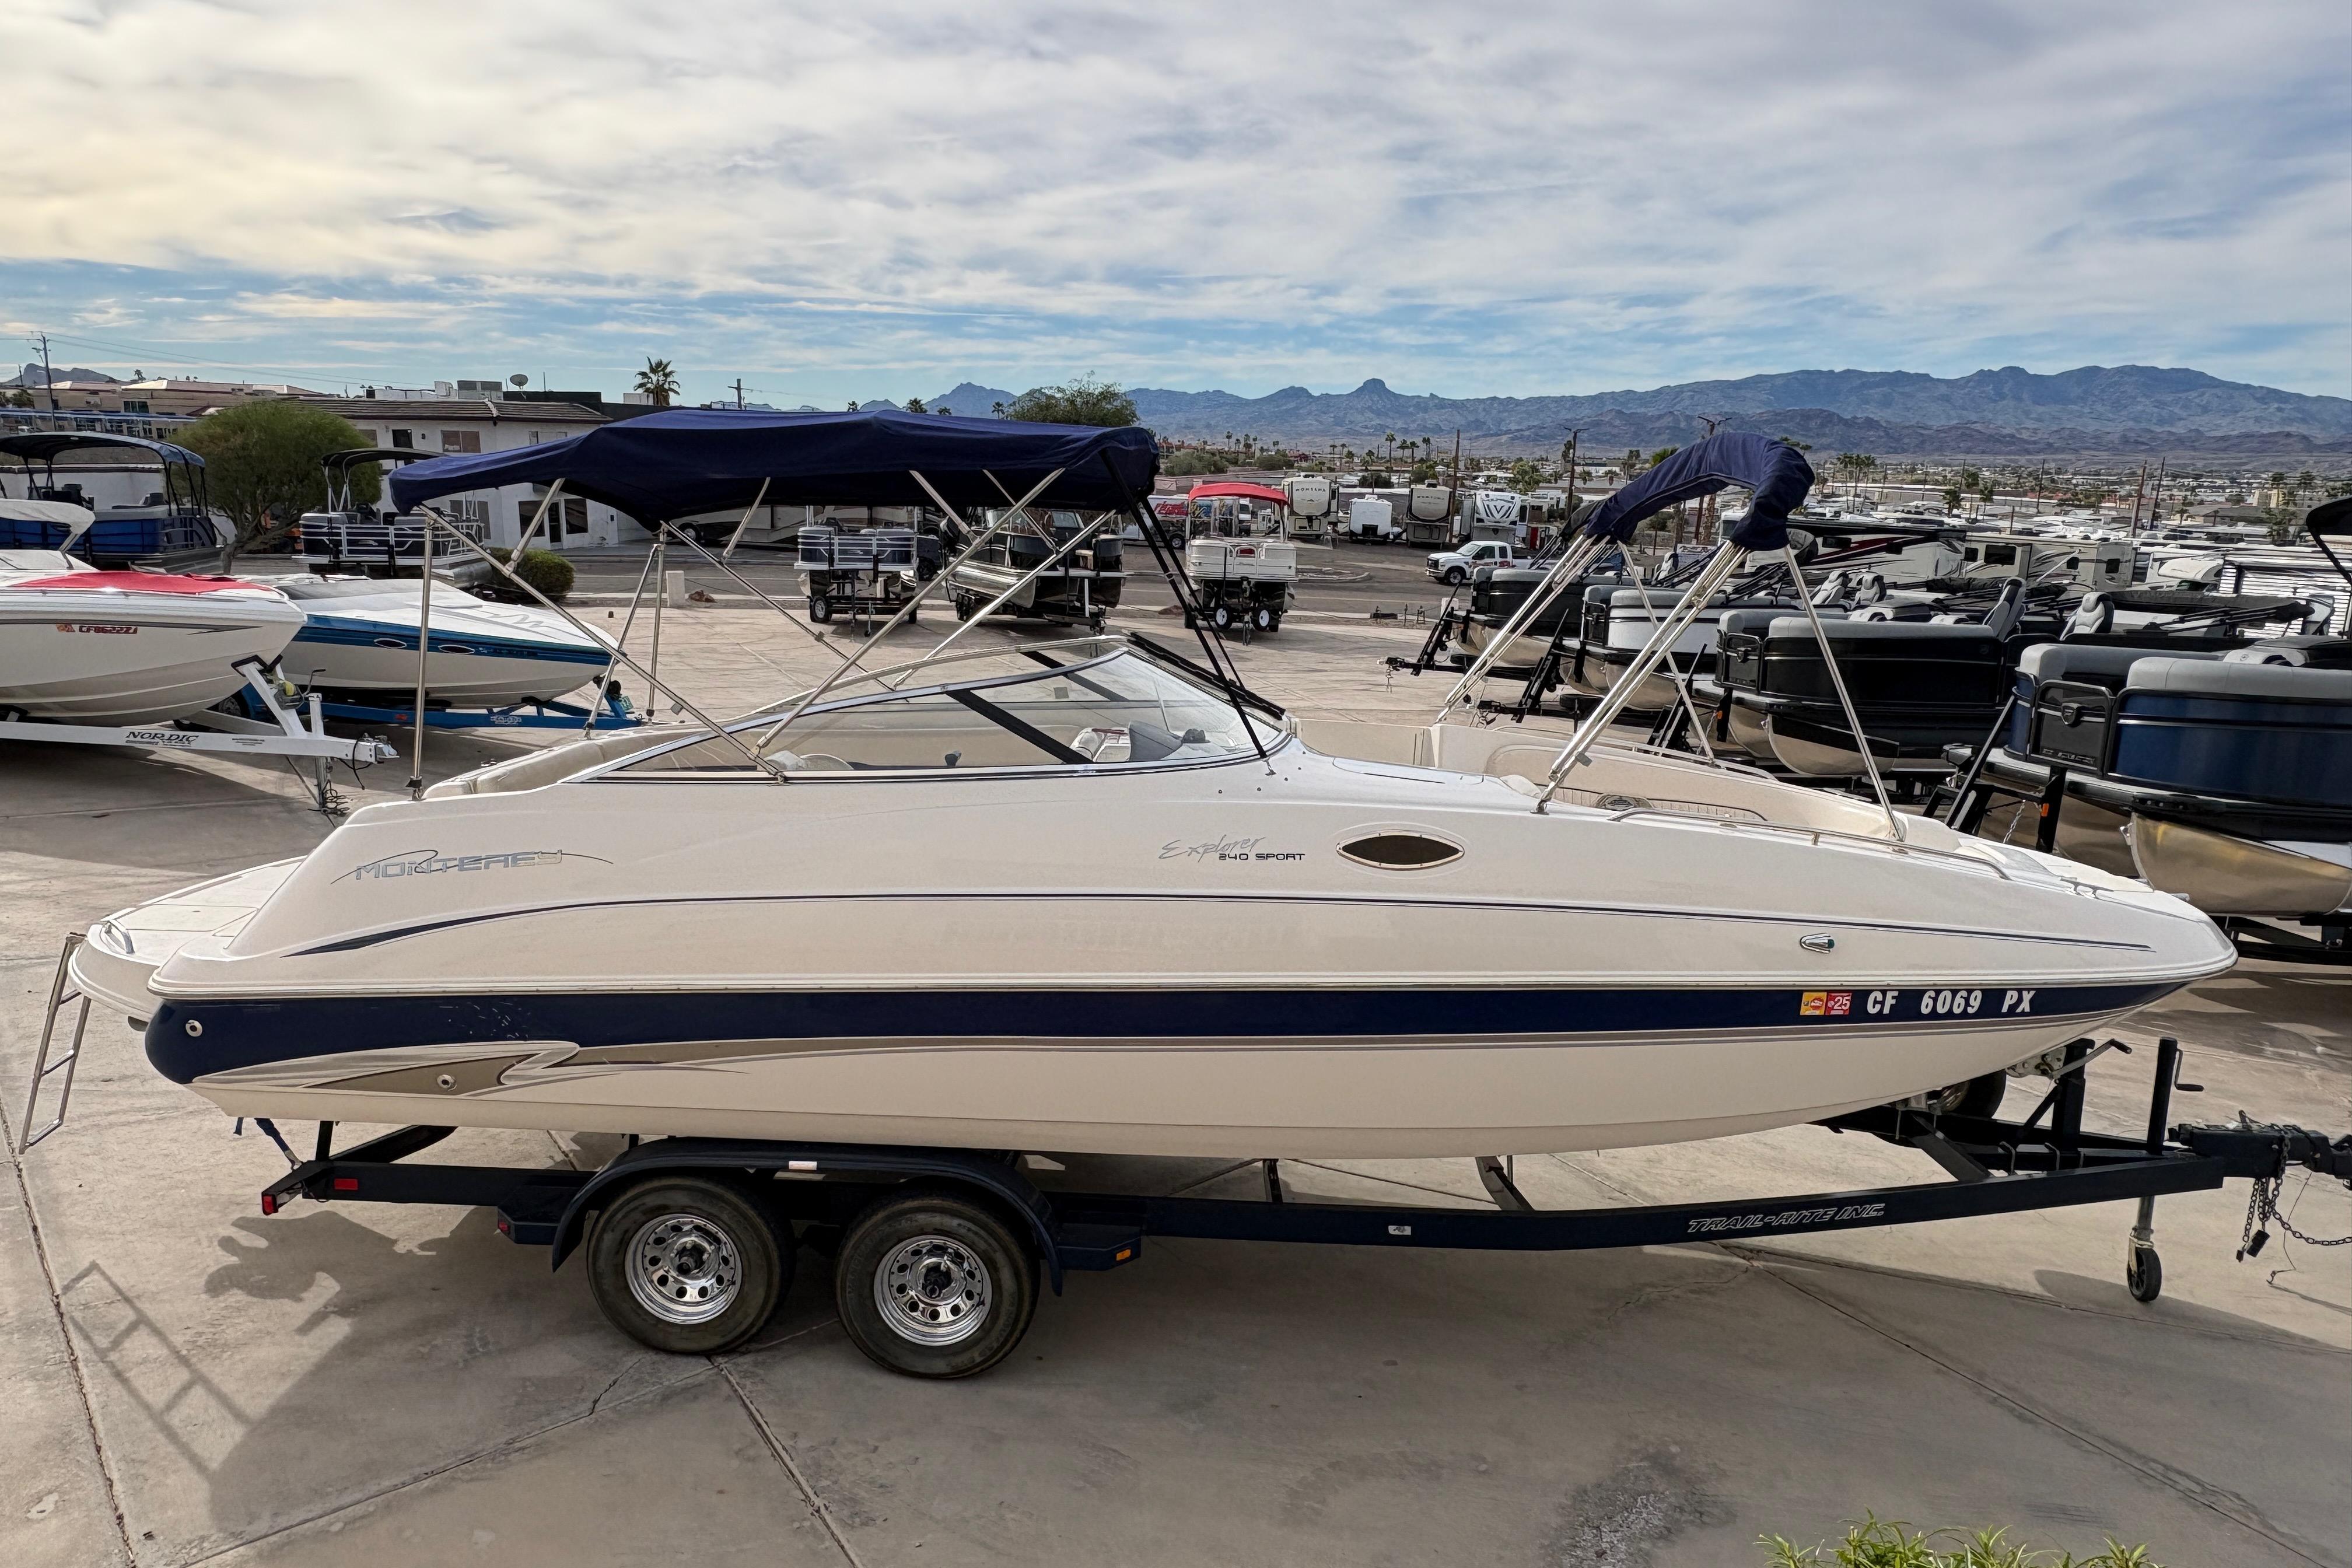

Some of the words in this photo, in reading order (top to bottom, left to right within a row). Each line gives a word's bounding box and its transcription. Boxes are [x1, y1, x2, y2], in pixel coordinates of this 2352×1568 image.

[126, 732, 199, 742] NORDIC
[1158, 834, 1266, 863] Explorer
[1833, 996, 1851, 1010] 25
[1867, 991, 1899, 1014] CF
[1920, 990, 1983, 1014] 6069
[2001, 991, 2036, 1013] PX
[1688, 1207, 1838, 1233] TRAIL-RITE
[1835, 1203, 1885, 1220] INC.
